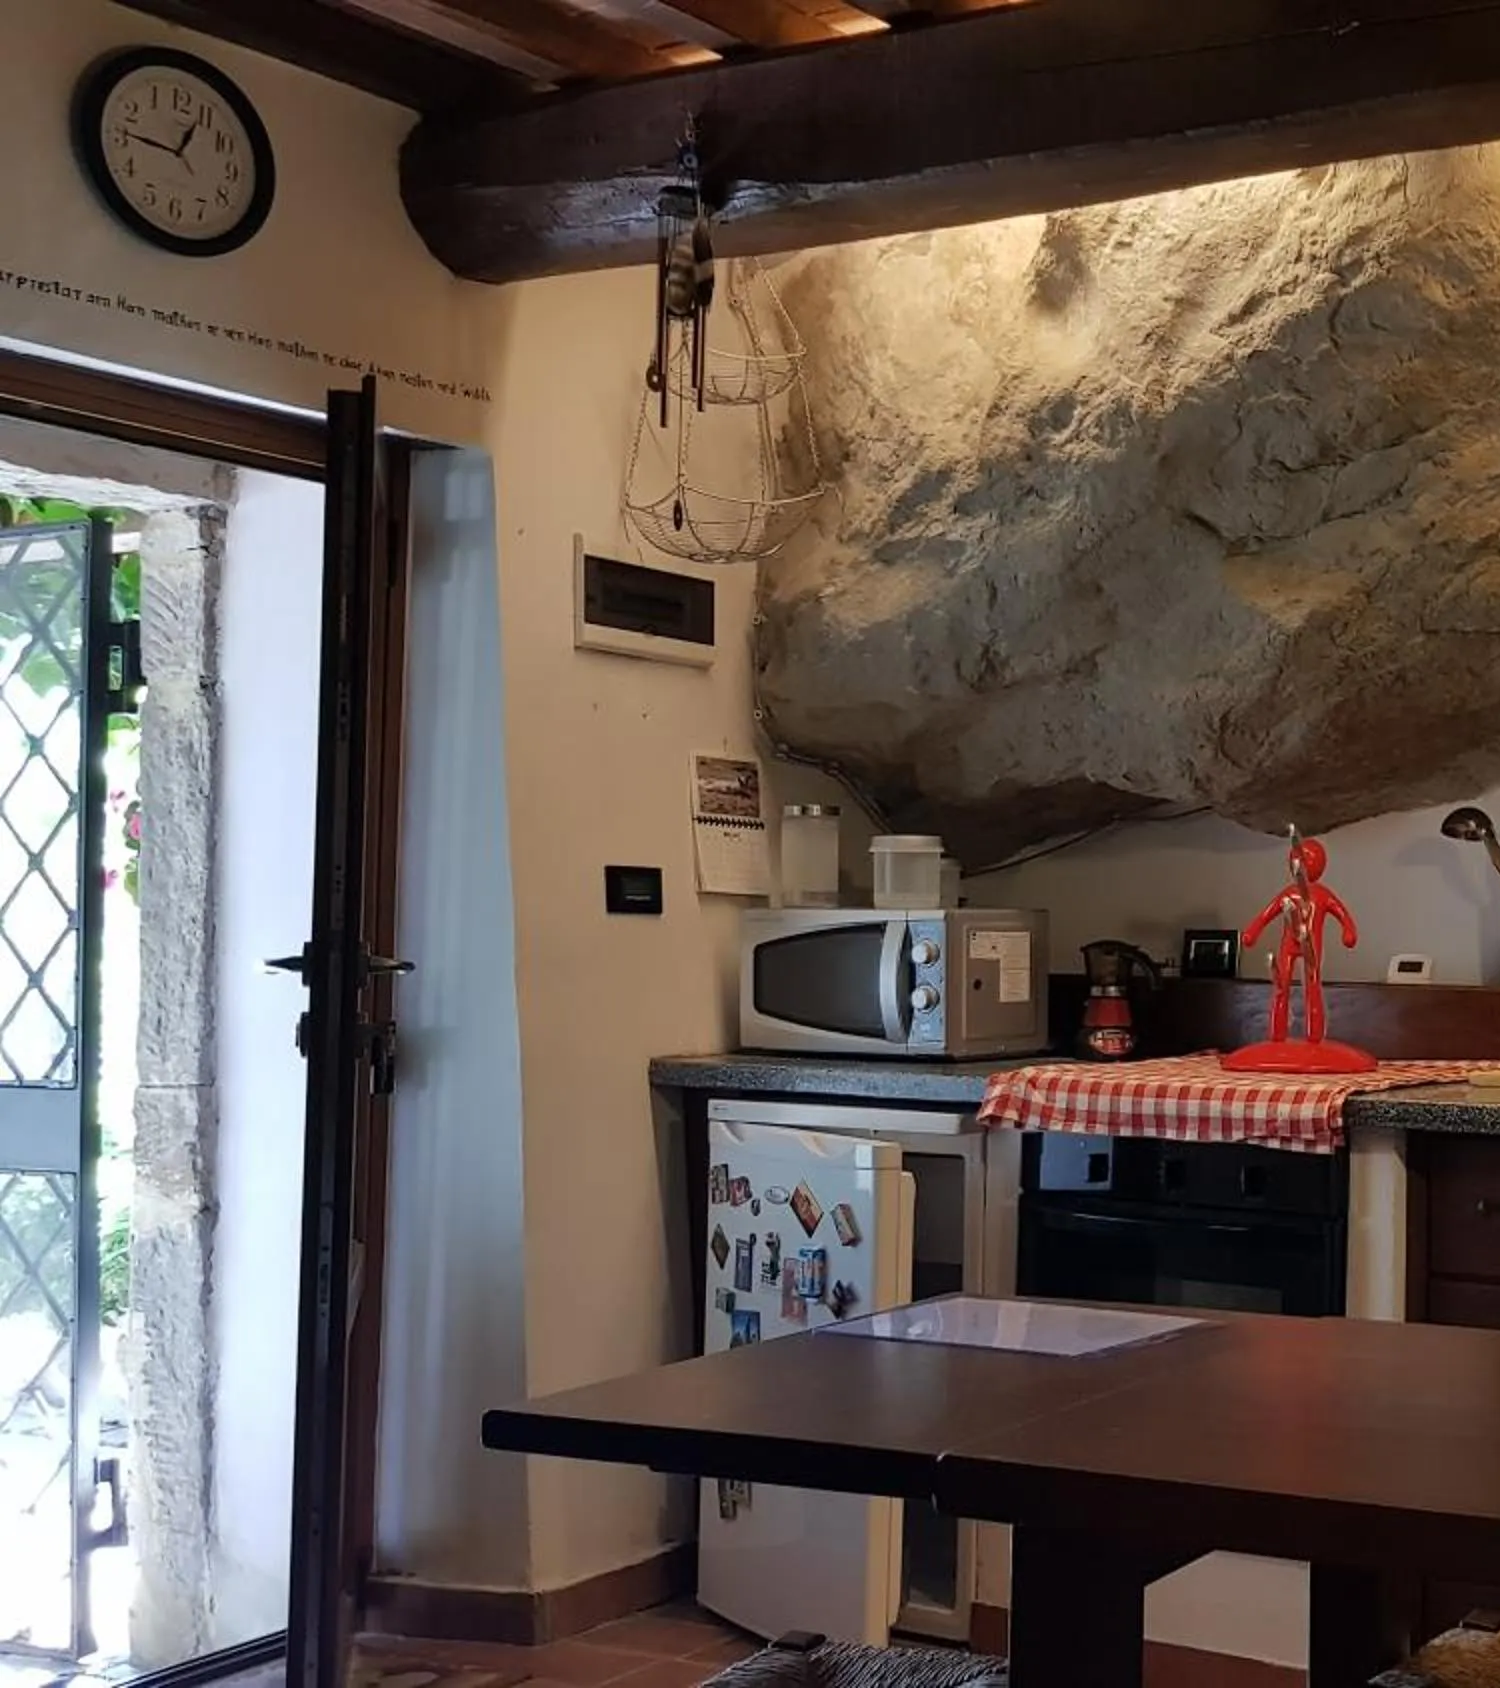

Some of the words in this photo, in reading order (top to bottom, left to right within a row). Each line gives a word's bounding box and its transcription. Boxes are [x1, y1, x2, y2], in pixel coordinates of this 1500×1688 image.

[124, 101, 139, 124] 2
[172, 87, 192, 115] 12
[199, 104, 213, 129] 11
[114, 124, 129, 148] 3
[215, 131, 234, 155] 10
[121, 155, 139, 178] 4
[225, 161, 239, 182] 9
[142, 182, 156, 207] 5
[215, 185, 231, 208] 8
[168, 196, 182, 221] 6
[195, 196, 208, 221] 7
